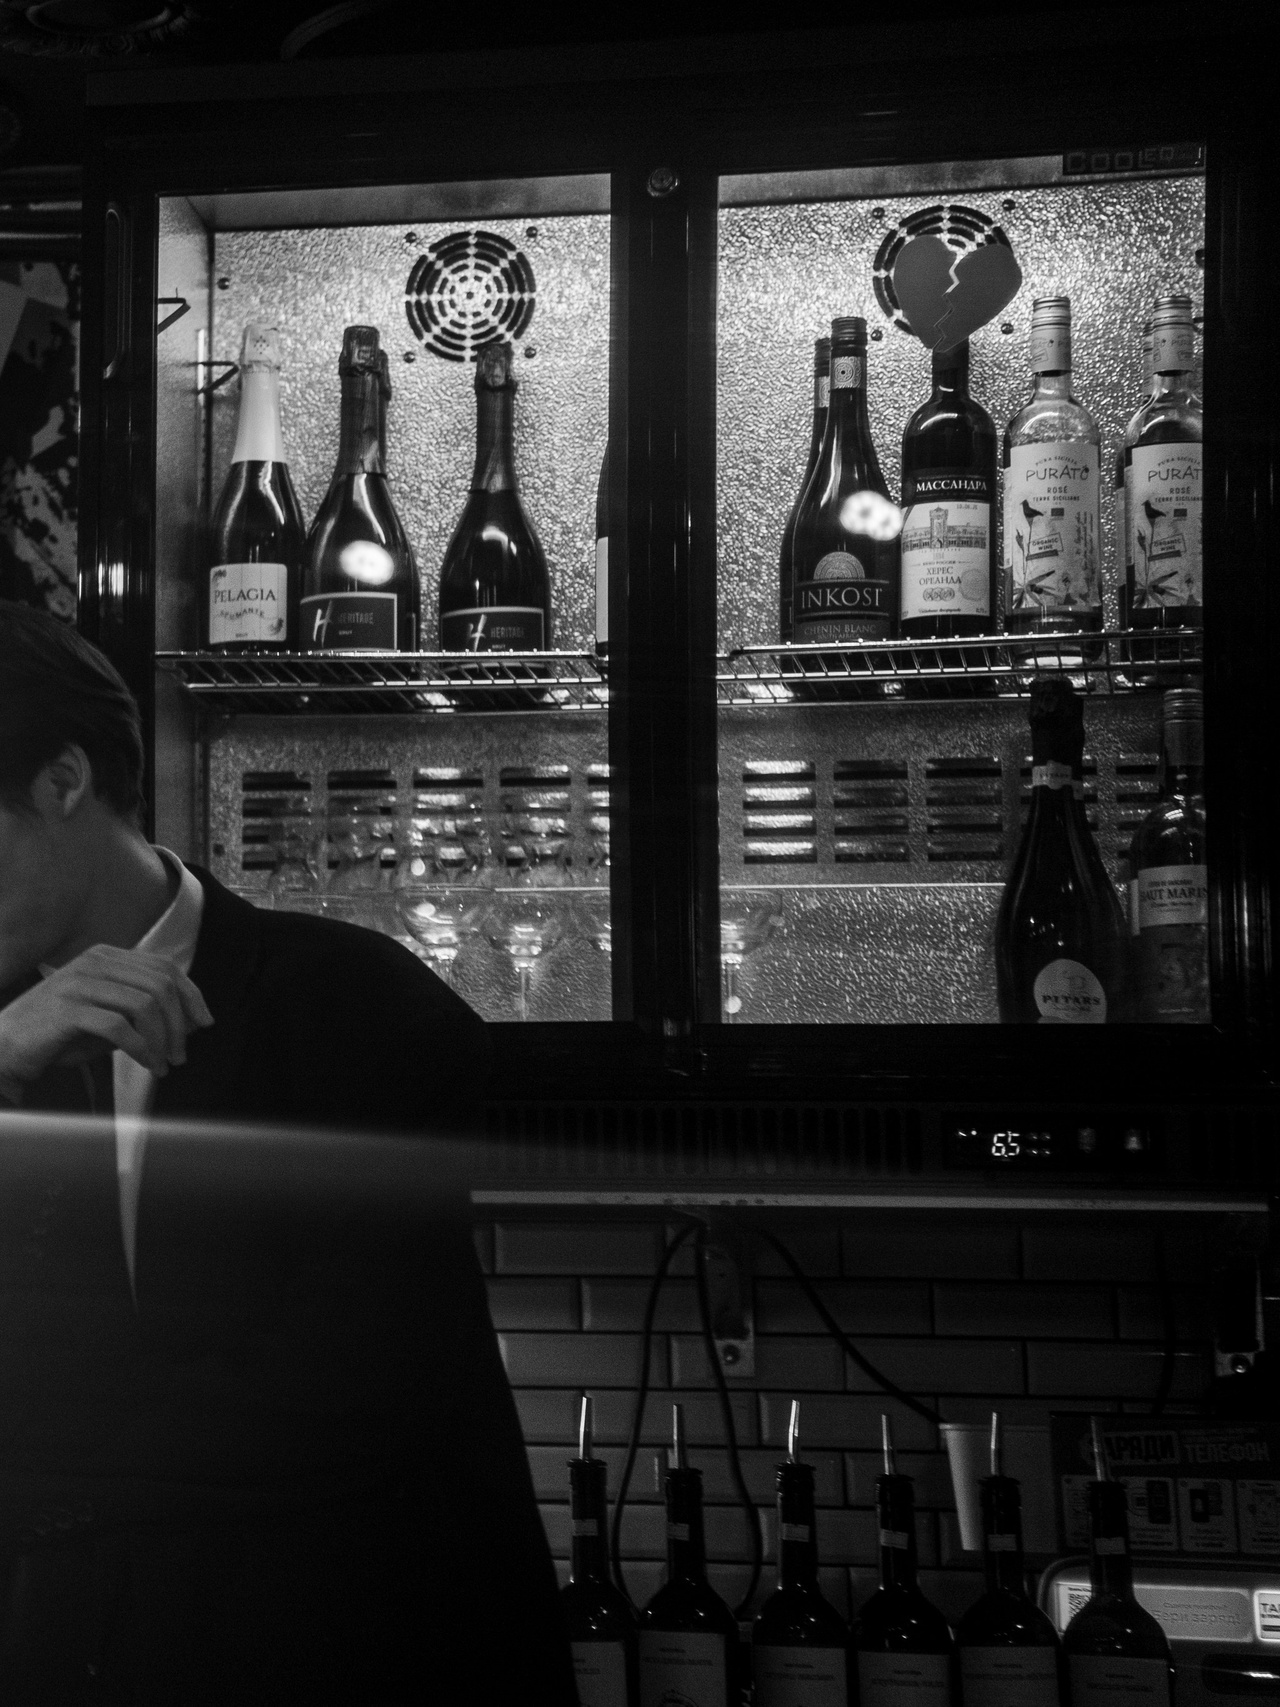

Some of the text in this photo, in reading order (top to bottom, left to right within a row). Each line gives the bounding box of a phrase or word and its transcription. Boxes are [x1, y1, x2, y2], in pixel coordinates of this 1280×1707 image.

[1026, 464, 1089, 481] PURATO
[1148, 465, 1203, 482] PURAT
[916, 480, 987, 492] МАССАНДРА
[1047, 485, 1068, 494] ROSÉ
[1169, 486, 1191, 494] ROSÉ
[1032, 537, 1059, 547] ORGANIC
[926, 566, 954, 575] ХЕРЕС
[919, 576, 962, 586] ОРЕАНДА
[214, 588, 276, 604] PELAGIA
[802, 586, 881, 610] INKOSI
[804, 624, 877, 636] CHENIN BLANC
[1184, 1441, 1270, 1464] ТЕЛЕФОН
